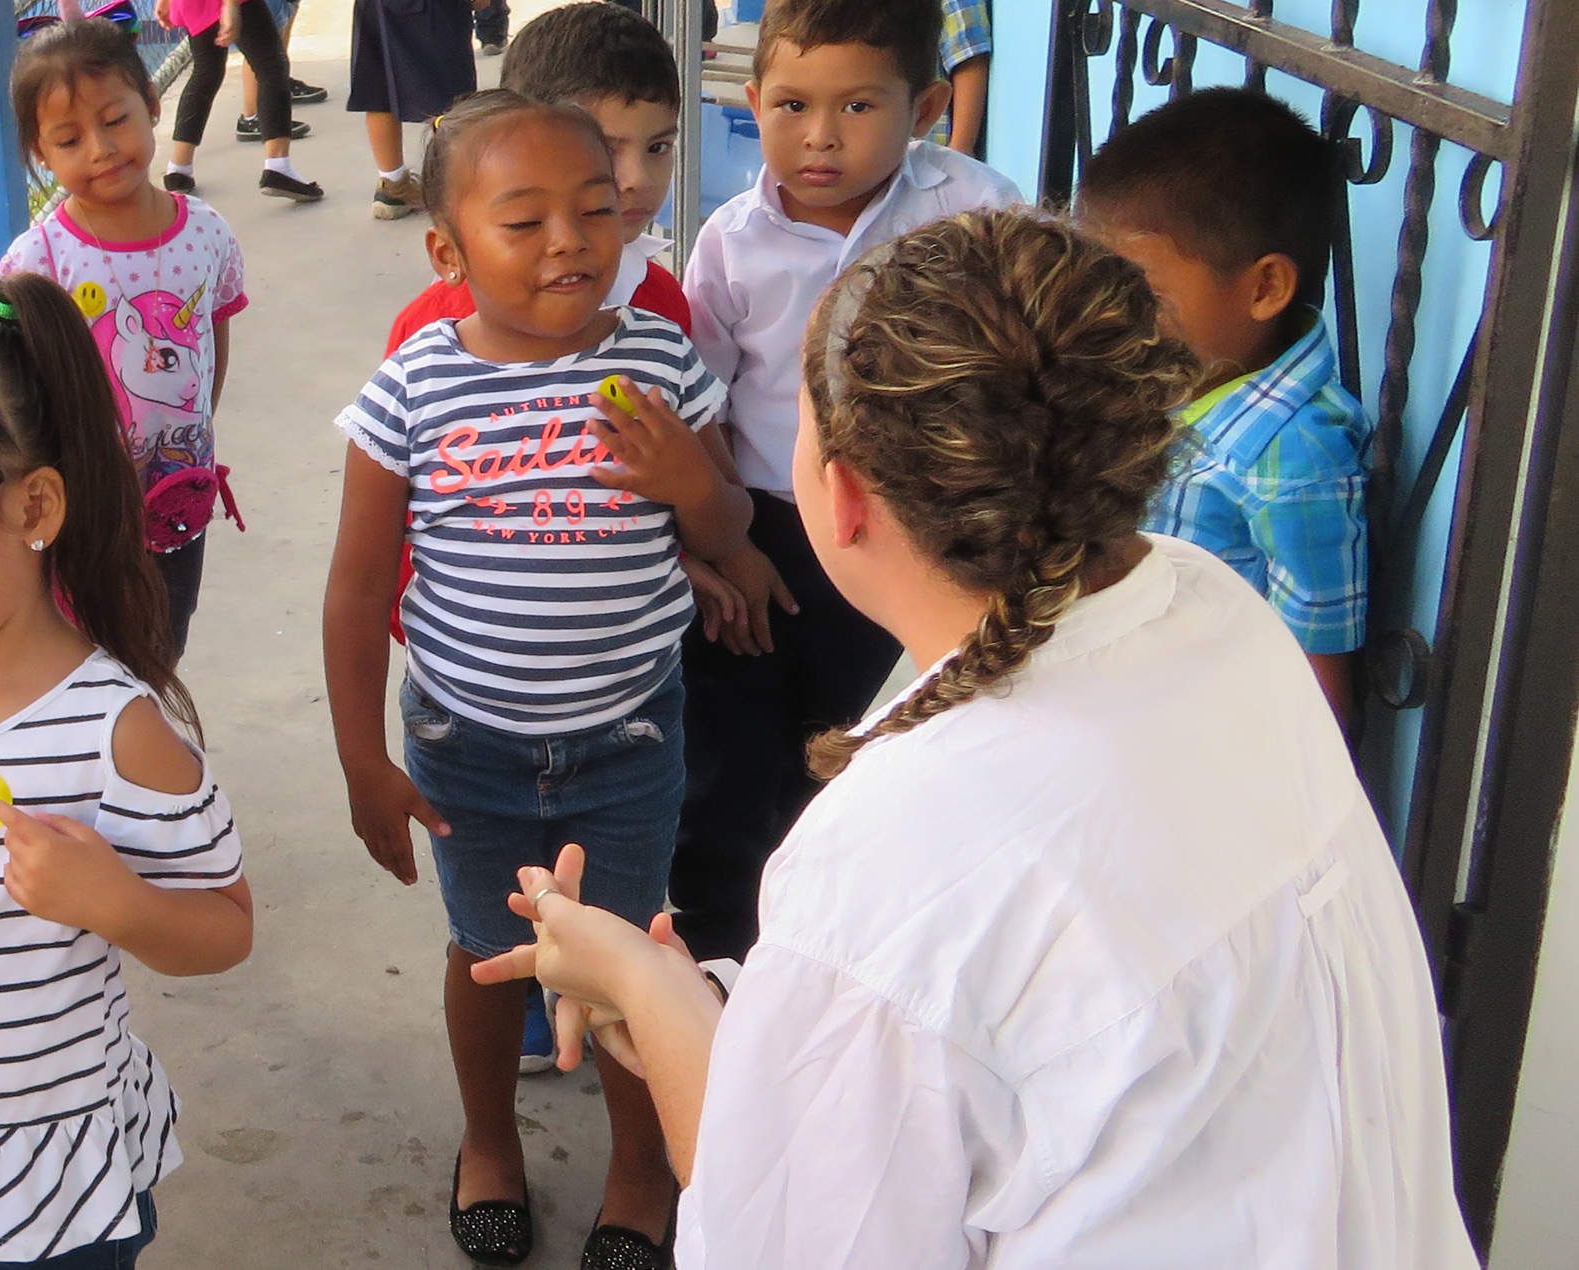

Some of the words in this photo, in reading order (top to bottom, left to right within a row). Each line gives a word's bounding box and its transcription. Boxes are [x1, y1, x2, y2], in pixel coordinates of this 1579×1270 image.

[472, 520, 515, 540] NEW
[528, 531, 587, 544] YORK
[597, 515, 639, 538] CITY
